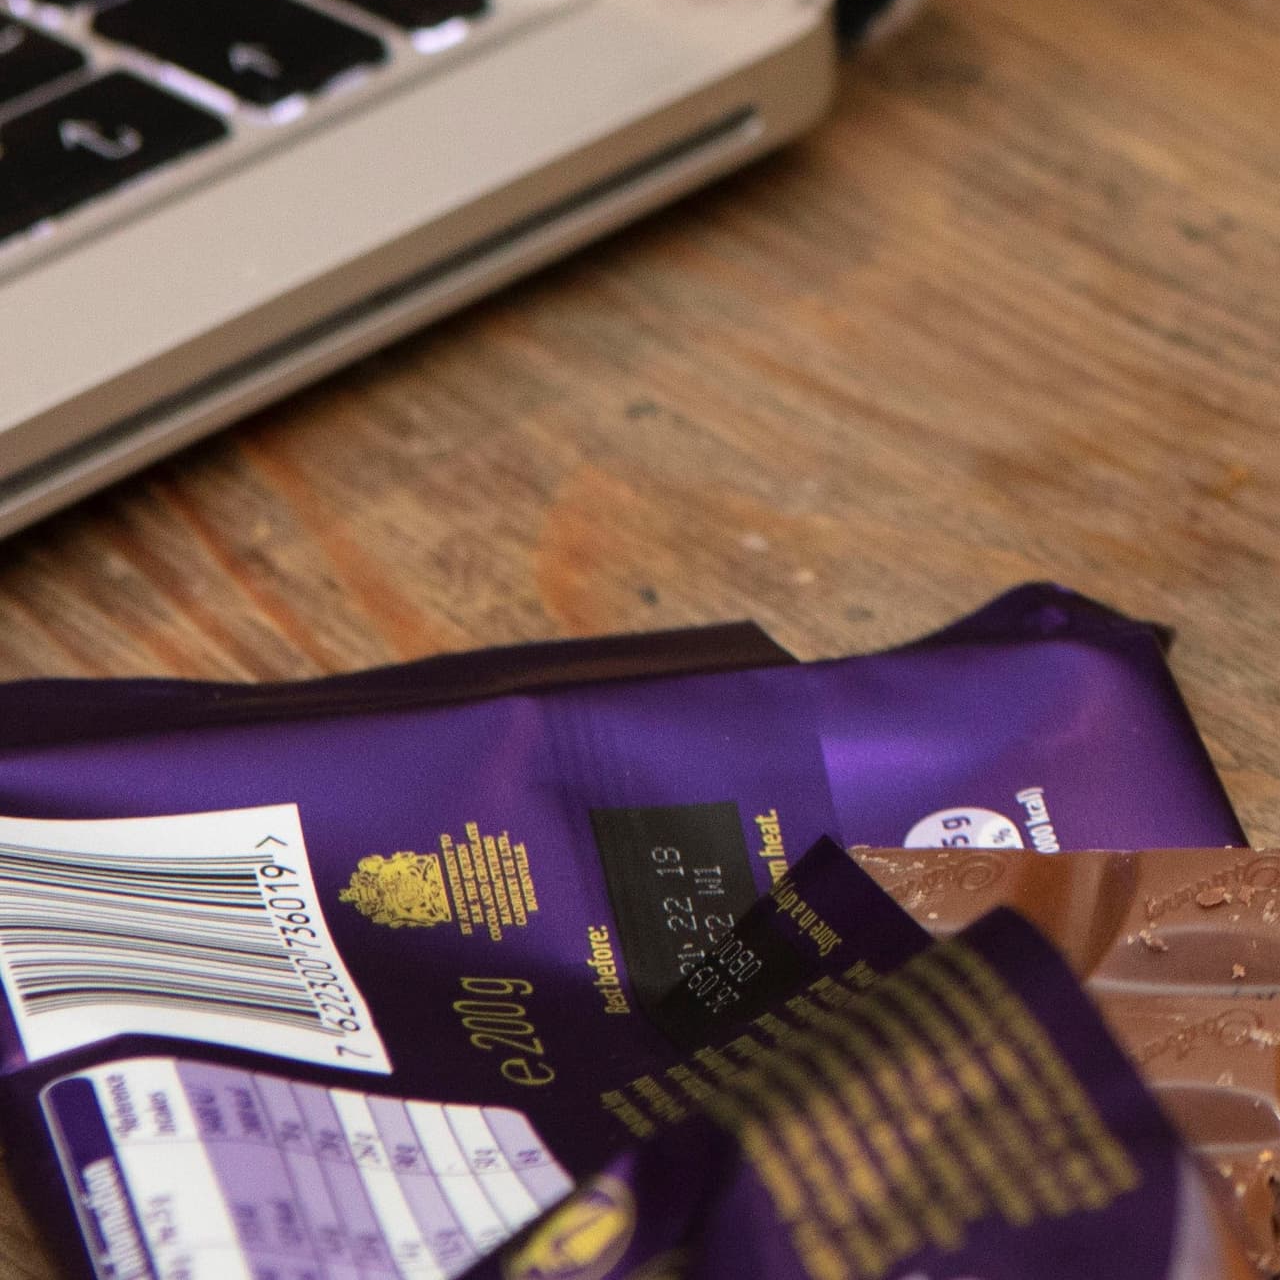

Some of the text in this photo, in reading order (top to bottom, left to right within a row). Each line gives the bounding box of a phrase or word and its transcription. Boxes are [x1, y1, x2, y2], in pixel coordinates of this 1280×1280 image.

[754, 807, 785, 856] heat.
[259, 862, 318, 951] 736019
[294, 957, 361, 1033] 622300
[587, 925, 631, 1014] Best before:
